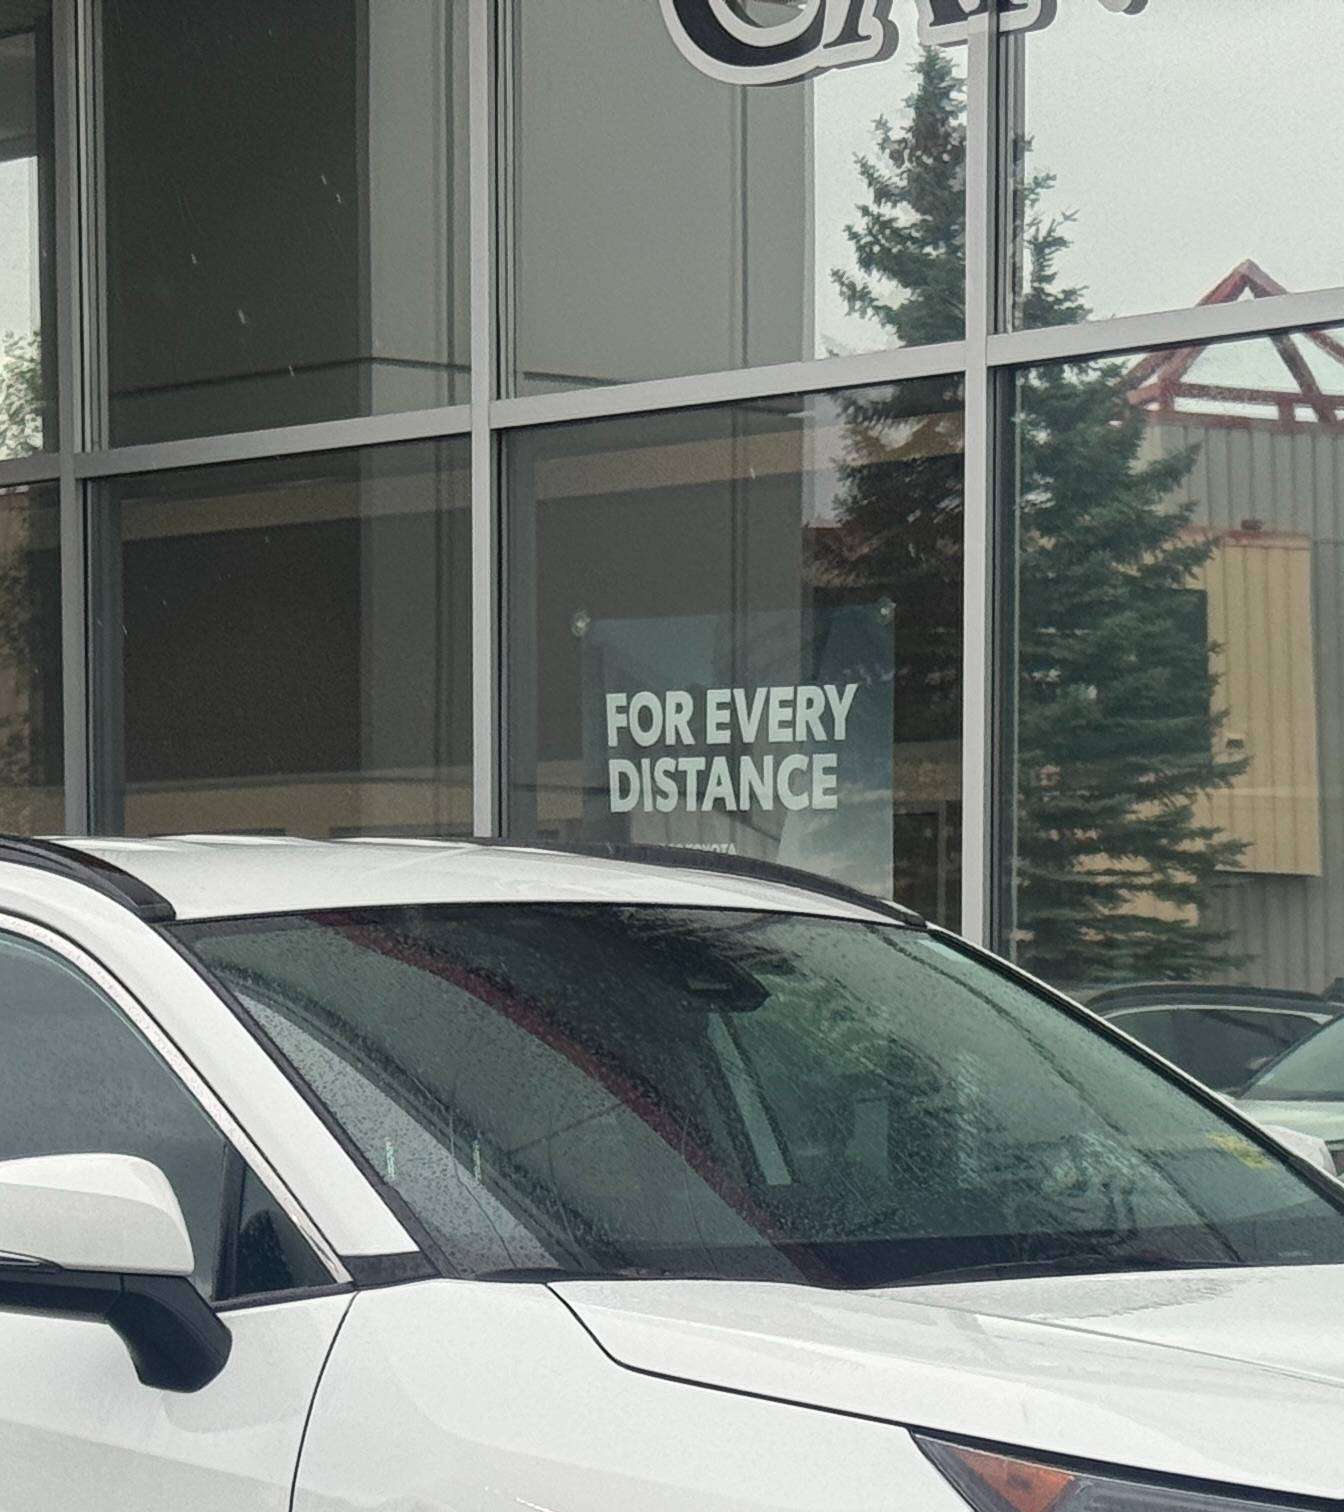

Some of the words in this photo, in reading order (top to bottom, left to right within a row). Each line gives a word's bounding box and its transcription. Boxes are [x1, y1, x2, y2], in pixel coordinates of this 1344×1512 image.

[606, 690, 695, 748] FOR
[706, 683, 859, 745] EVERY
[609, 752, 838, 814] DISTANCE
